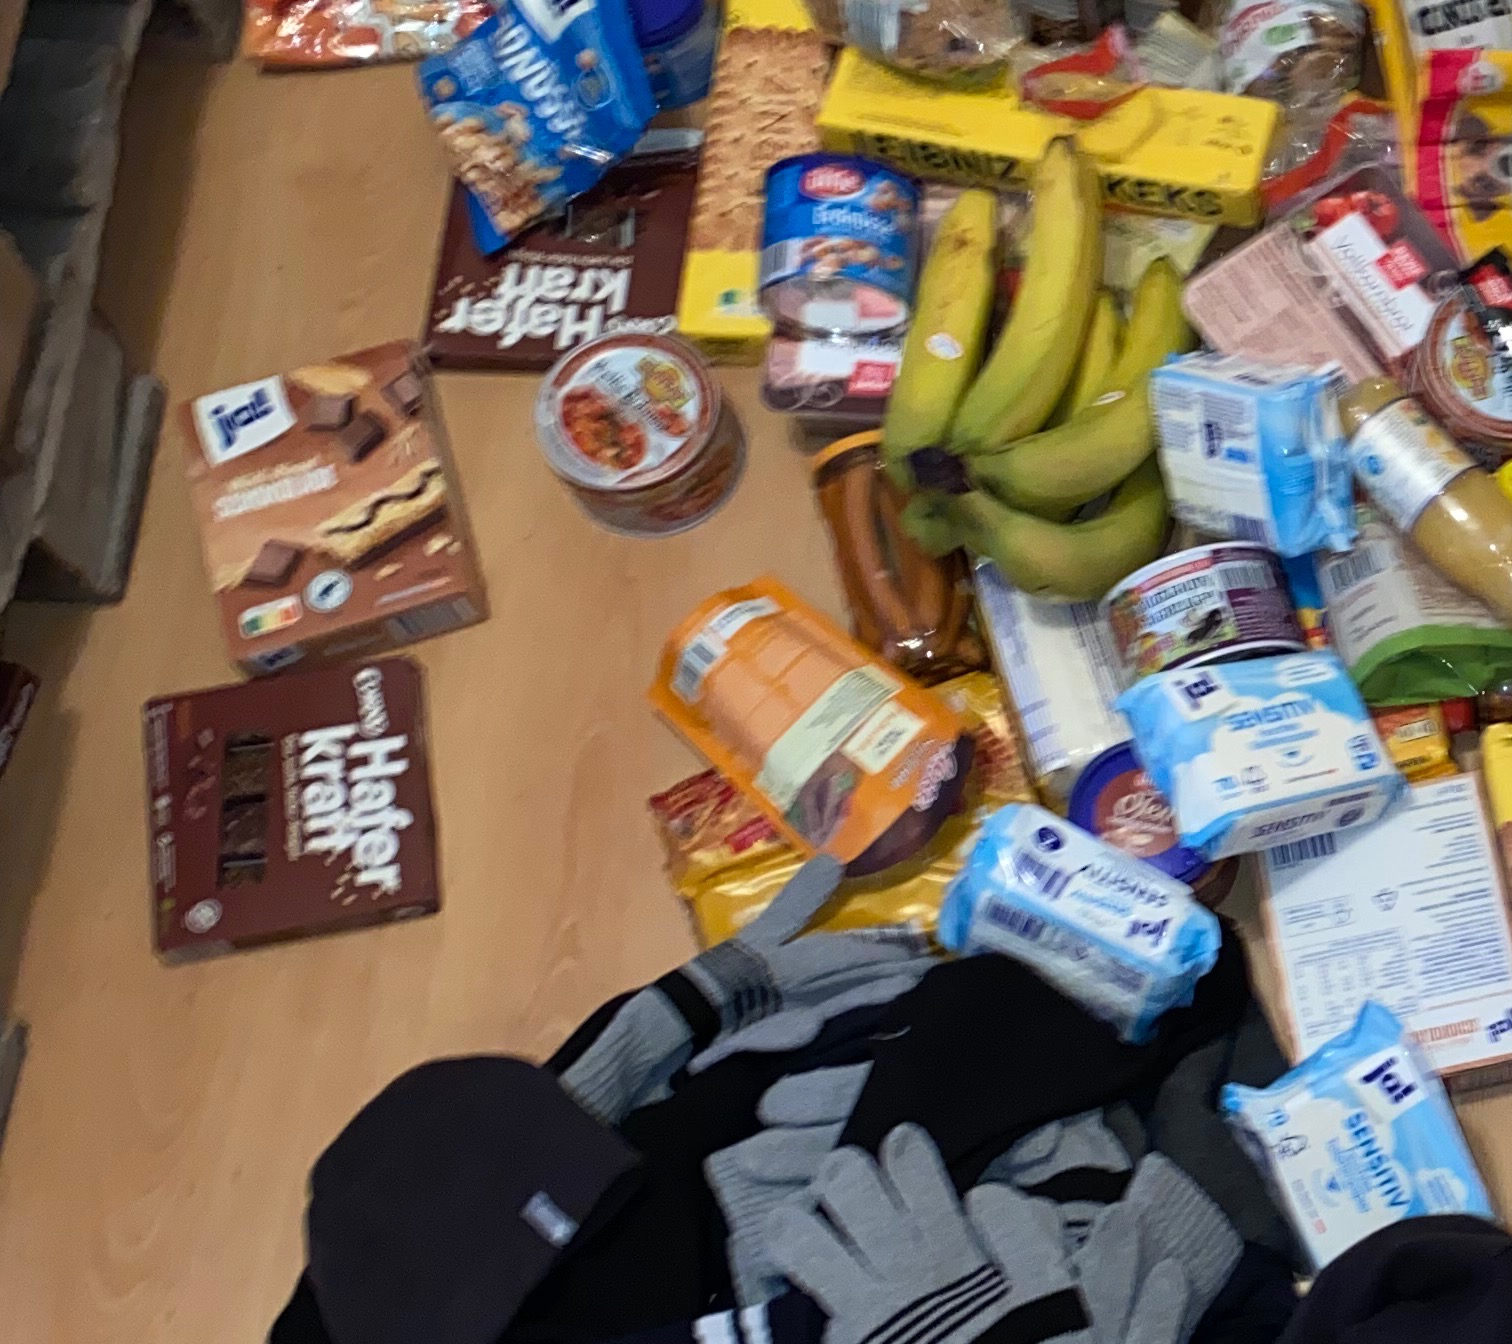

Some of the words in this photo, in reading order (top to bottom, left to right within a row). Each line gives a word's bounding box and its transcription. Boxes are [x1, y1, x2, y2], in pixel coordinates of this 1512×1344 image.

[1104, 174, 1222, 218] KEKS
[497, 263, 634, 313] kraft
[436, 296, 602, 350] Hafer
[211, 388, 275, 449] ja!
[301, 724, 358, 854] kraft
[350, 734, 413, 894] Hafer
[1362, 1059, 1418, 1104] ja!
[1342, 1111, 1408, 1209] SENSITIV
